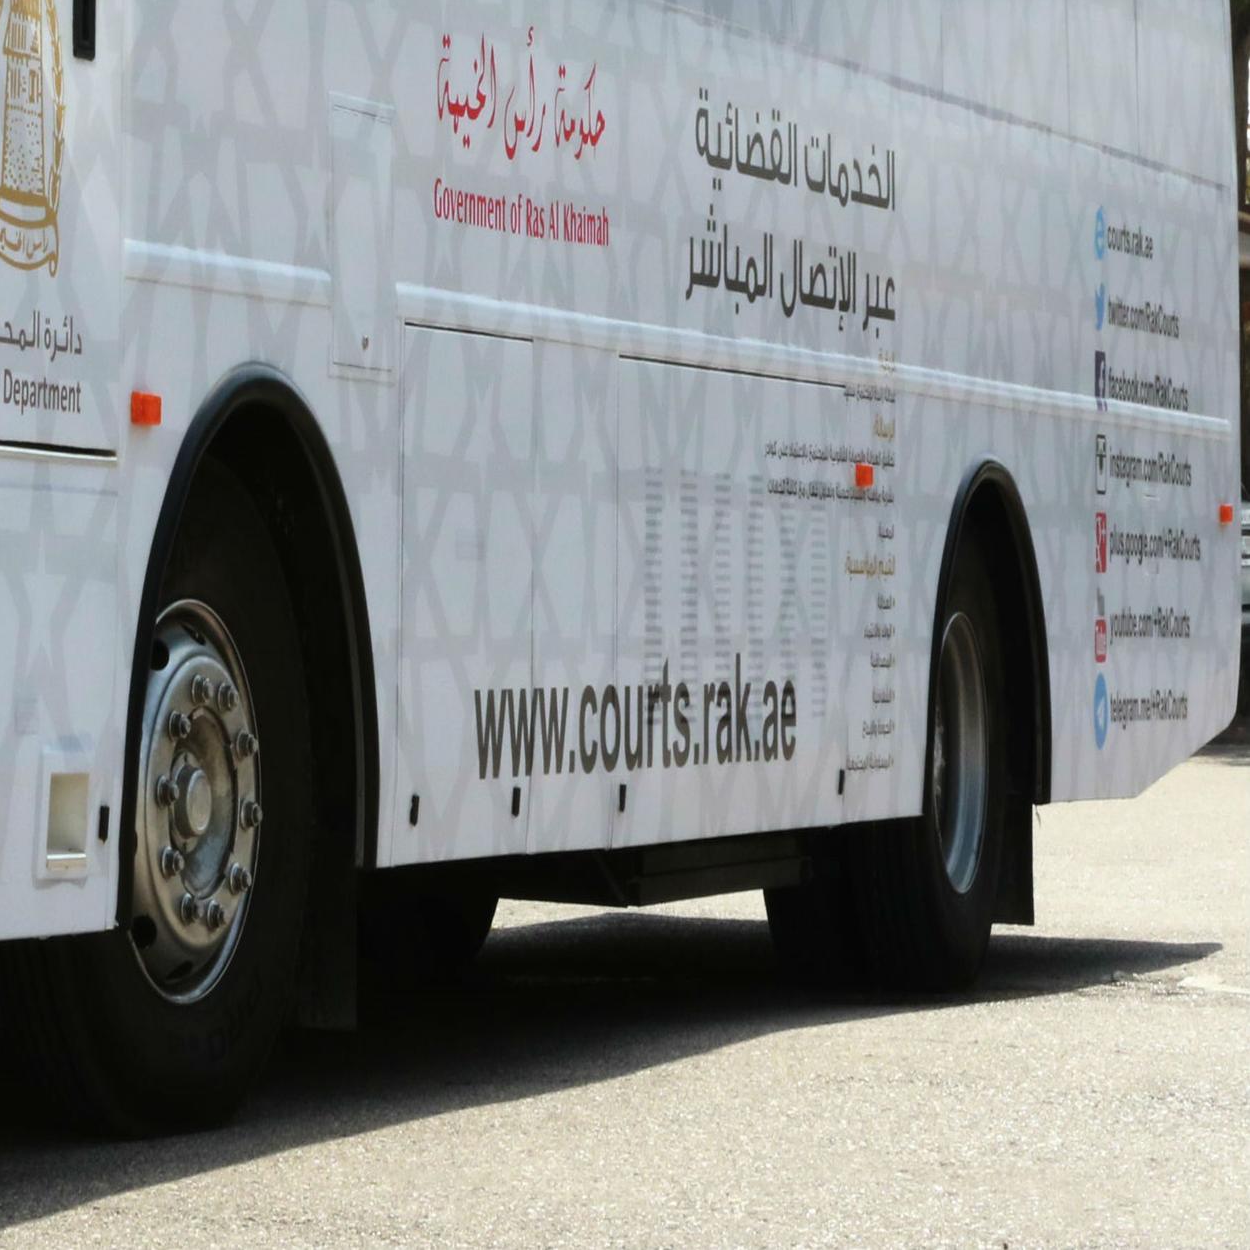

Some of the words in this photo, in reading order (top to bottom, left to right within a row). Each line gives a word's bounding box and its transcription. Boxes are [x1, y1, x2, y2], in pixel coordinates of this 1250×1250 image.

[437, 31, 497, 149] الخيمة
[504, 26, 546, 160] رأس
[555, 62, 605, 160] حكومة
[695, 88, 798, 192] القضائية
[804, 134, 896, 211] الخدمات
[433, 177, 507, 233] Government
[511, 192, 522, 234] of
[526, 198, 545, 239] Ras
[549, 201, 559, 241] Al
[563, 202, 610, 247] Khaimah
[1107, 226, 1153, 259] courts.rak.ae
[685, 203, 774, 315] المباشر
[780, 239, 857, 331] الإتصال
[862, 269, 896, 339] عبر
[44, 315, 82, 362] دائرة
[4, 368, 81, 415] Department
[474, 652, 797, 780] www.courts.rak.ae
